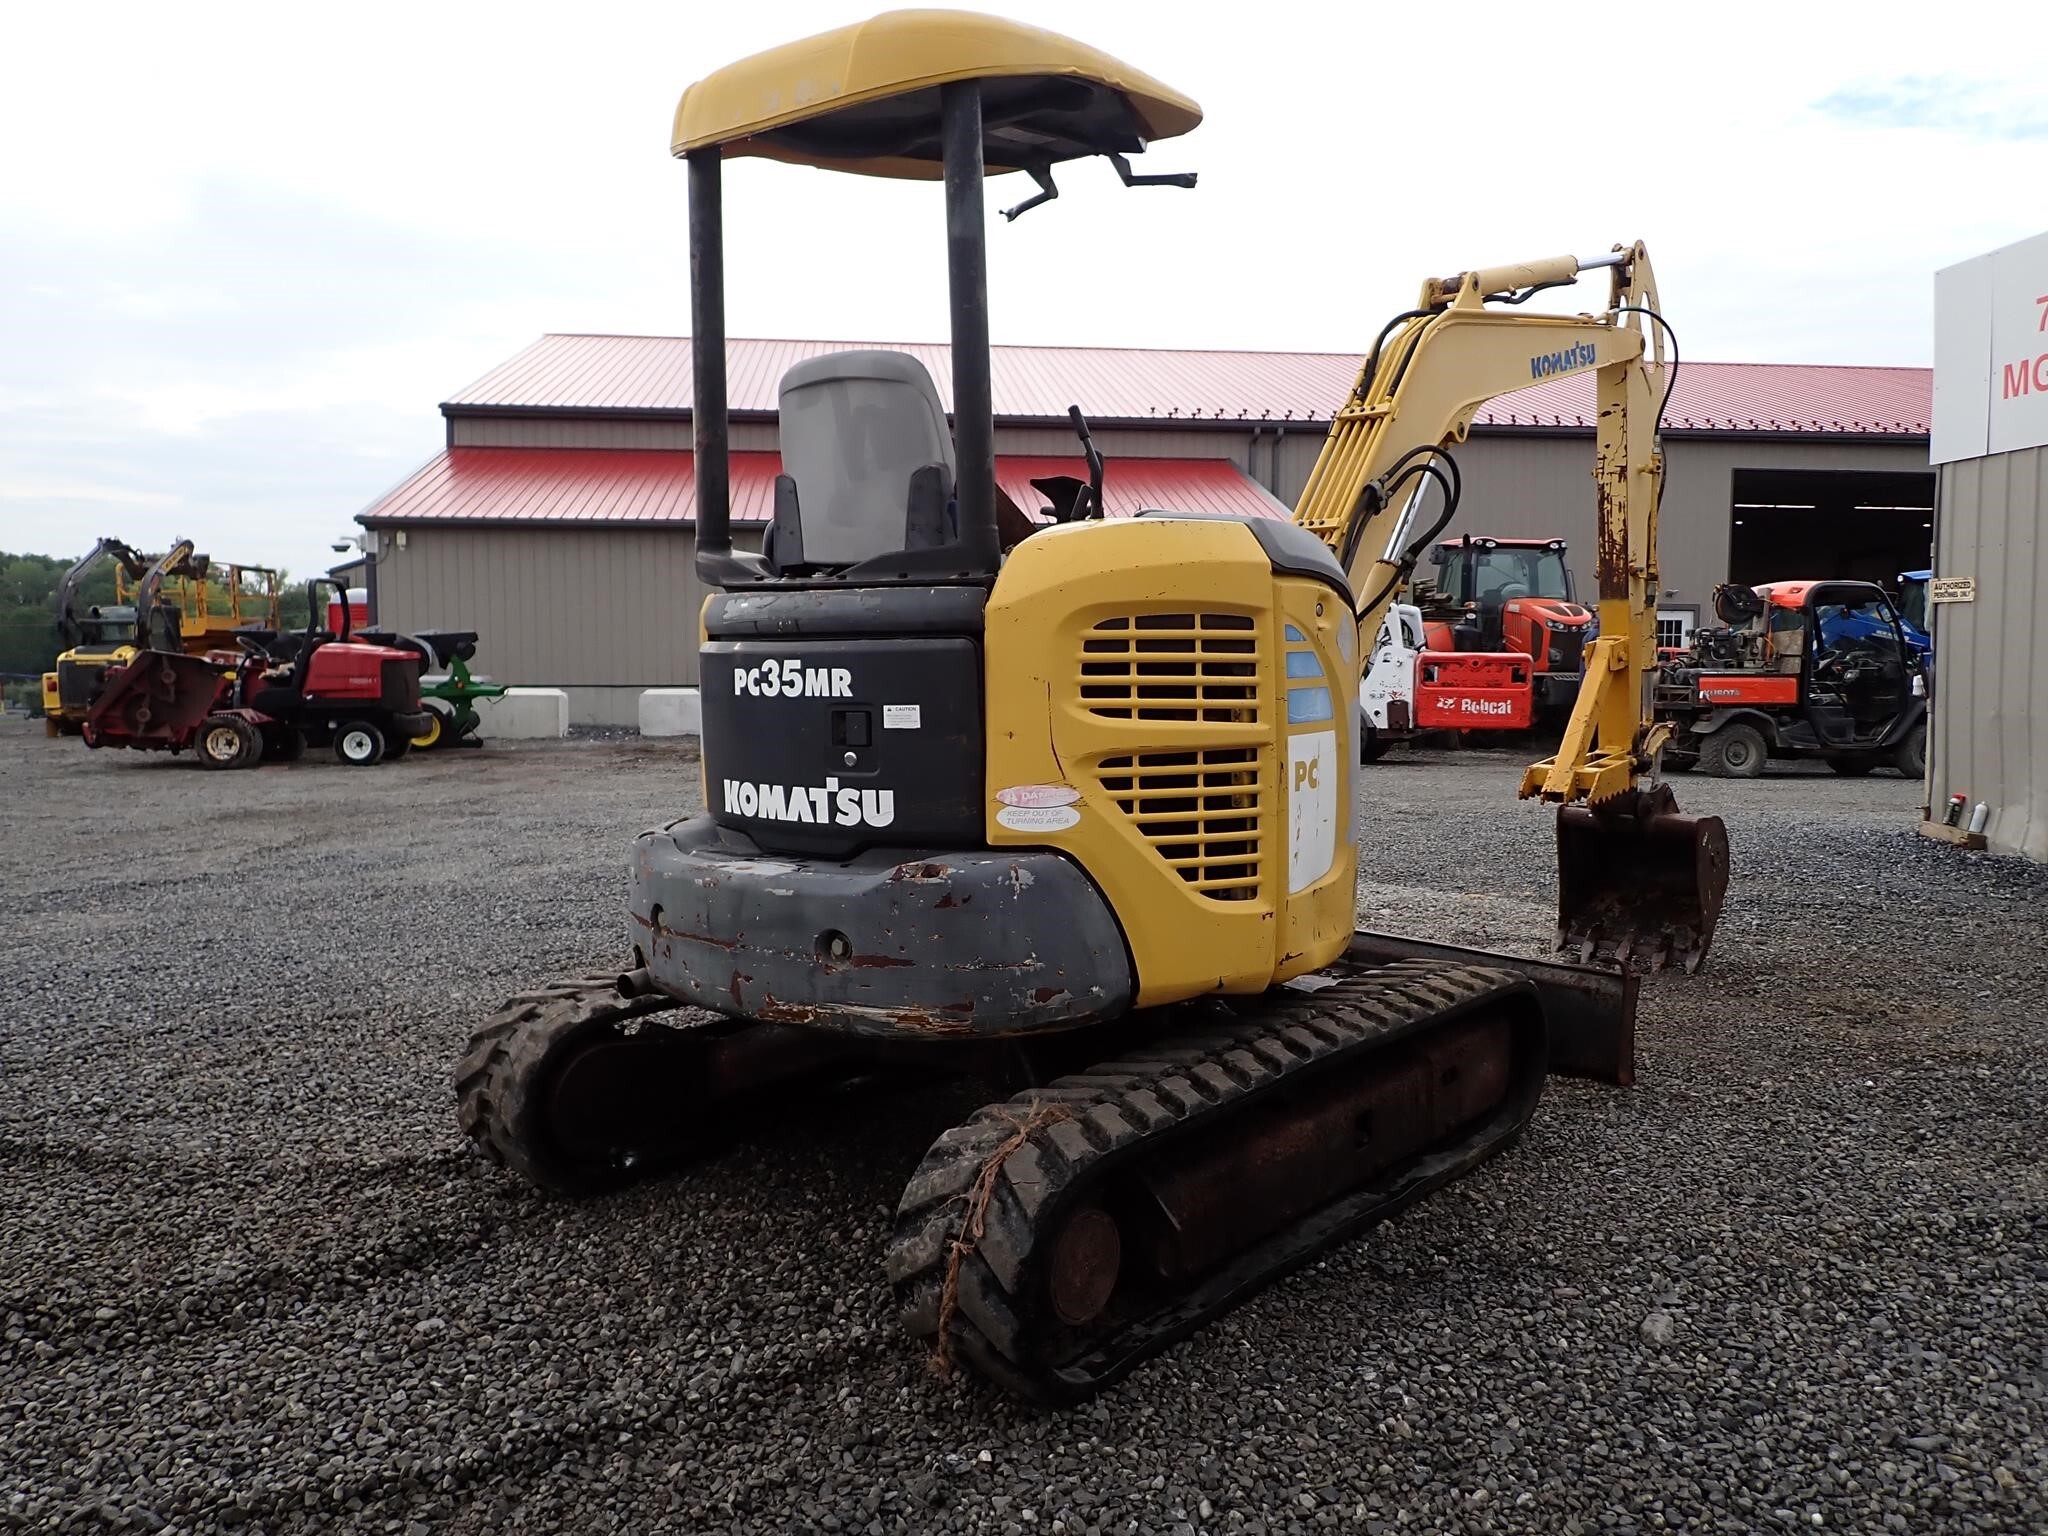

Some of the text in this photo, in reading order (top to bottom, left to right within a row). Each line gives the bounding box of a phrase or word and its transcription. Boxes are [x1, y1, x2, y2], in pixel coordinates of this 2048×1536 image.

[1531, 340, 1595, 378] KOMATSU
[1934, 581, 1971, 590] AUTHORIZED
[734, 659, 853, 697] PC35MR
[1461, 698, 1512, 714] Bobcat
[1294, 758, 1319, 792] PC
[723, 777, 895, 828] KOMATSU
[1006, 817, 1044, 825] TURNING
